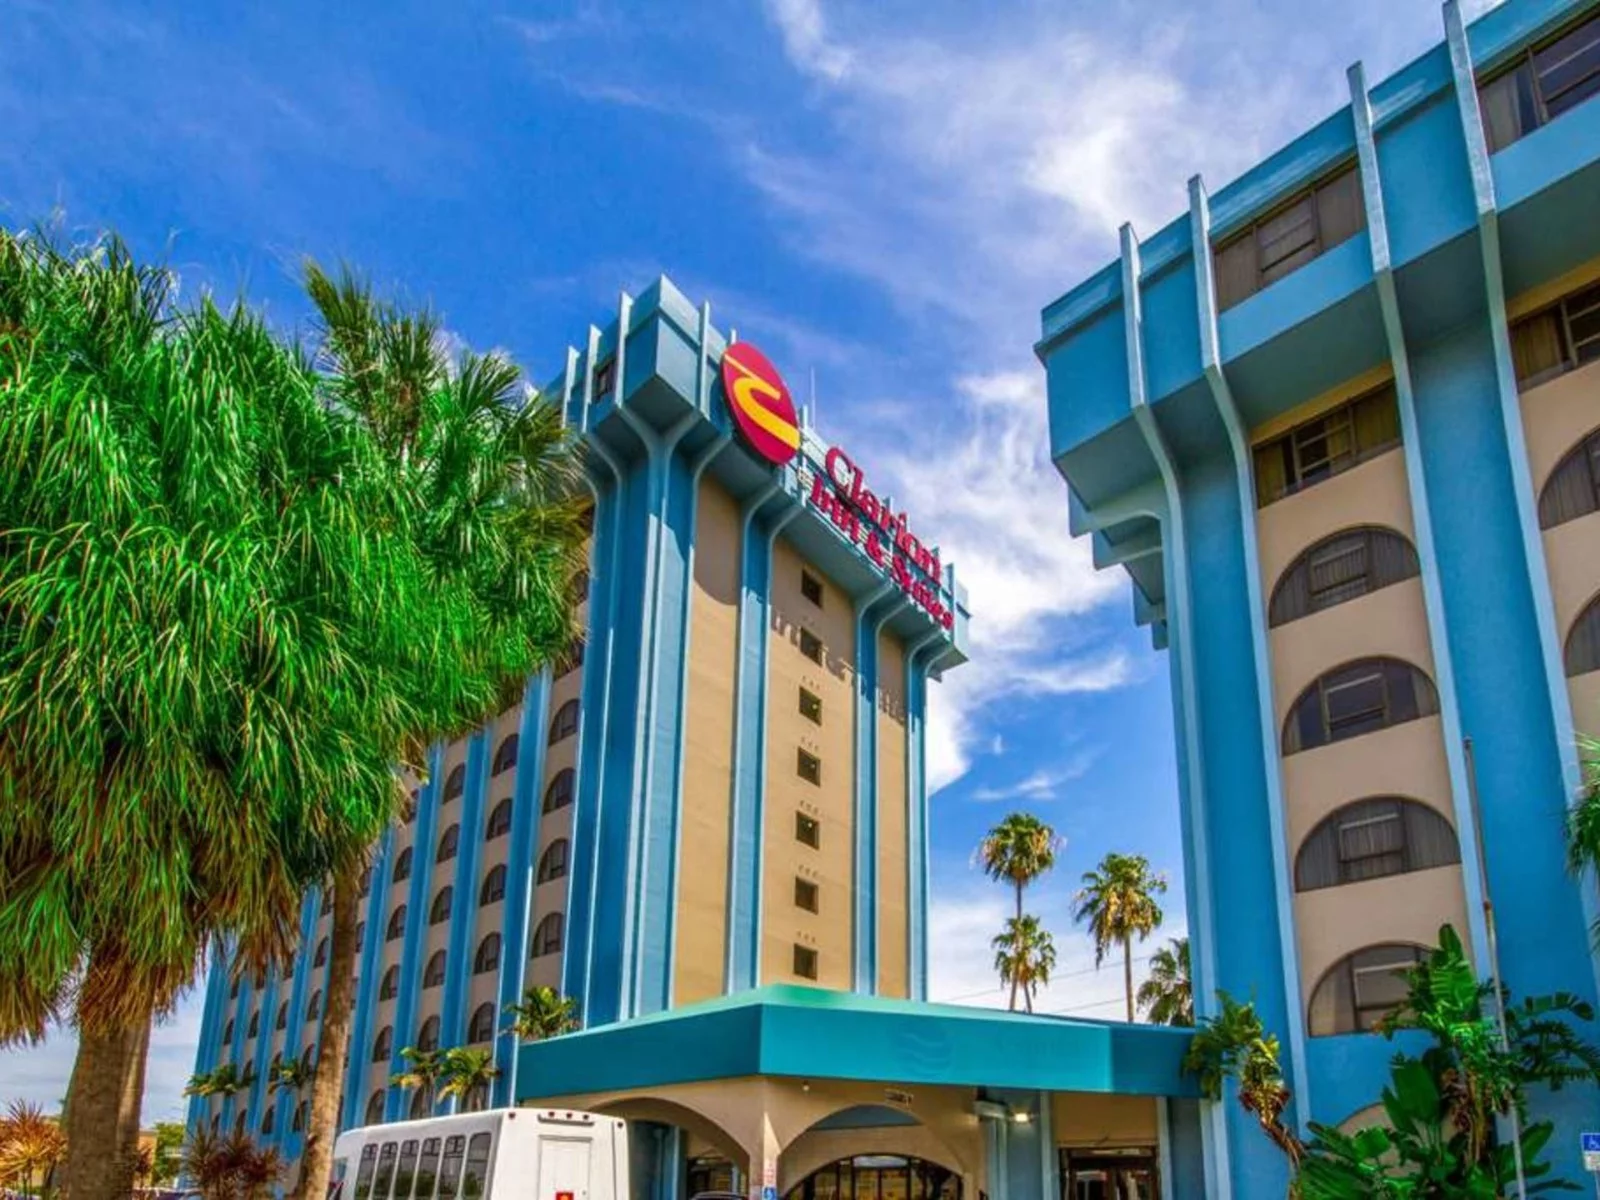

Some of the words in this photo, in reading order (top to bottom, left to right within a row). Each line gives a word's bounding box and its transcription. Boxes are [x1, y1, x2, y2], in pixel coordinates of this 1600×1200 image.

[810, 473, 860, 544] Inn
[865, 531, 884, 567] &
[890, 554, 953, 630] Suites
[825, 447, 941, 588] Clarion
